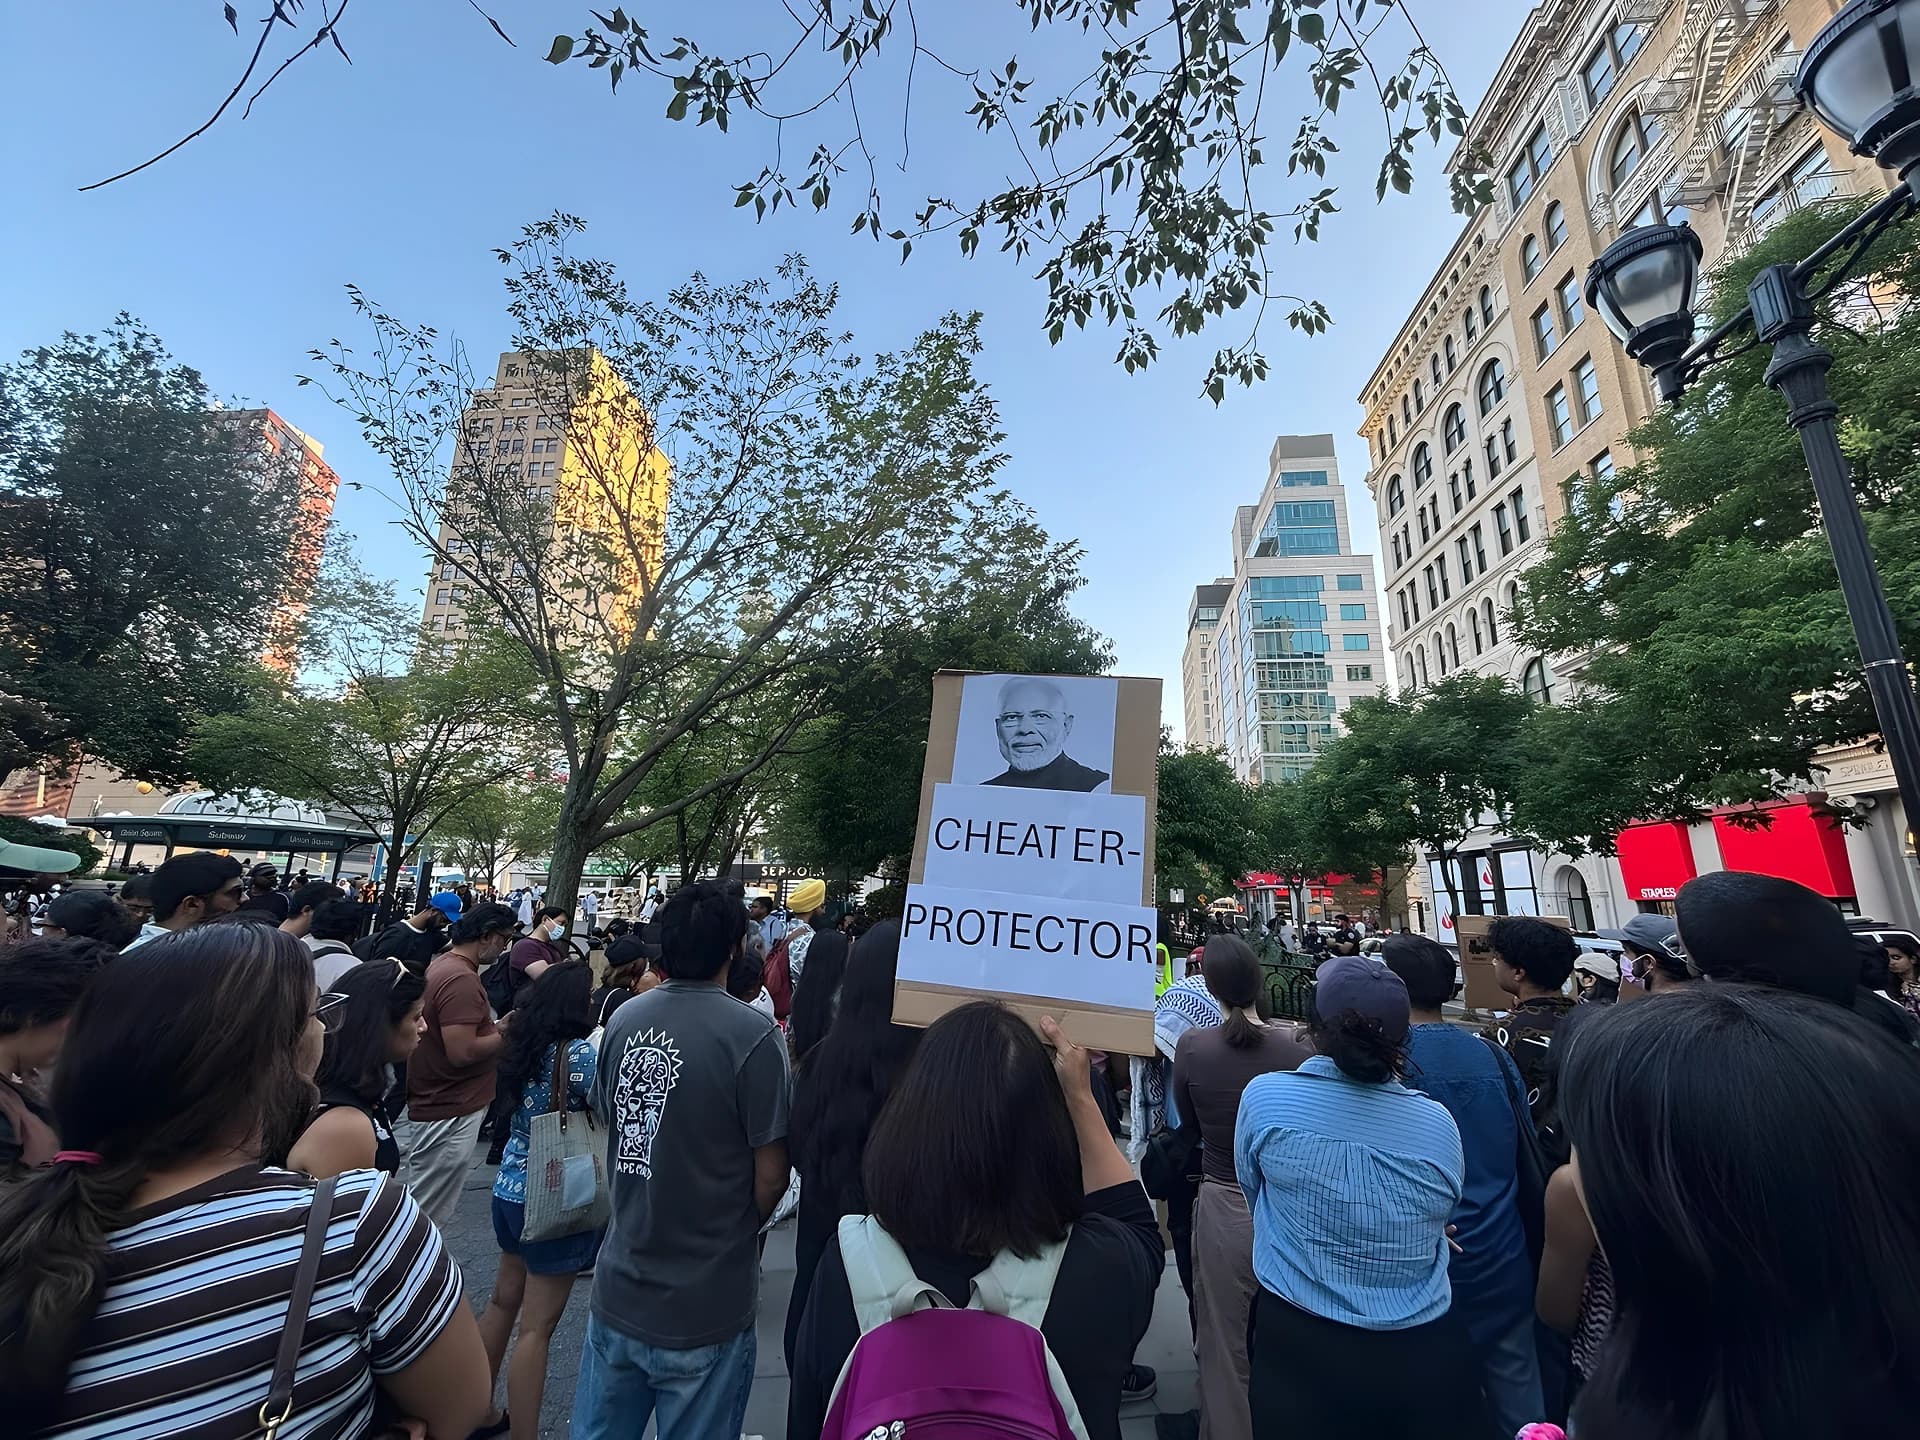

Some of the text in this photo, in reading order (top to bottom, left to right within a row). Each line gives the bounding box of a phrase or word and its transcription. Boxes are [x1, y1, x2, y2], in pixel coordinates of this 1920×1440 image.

[208, 830, 247, 841] Subway
[935, 817, 1141, 866] CHEATER-
[1641, 887, 1677, 898] STAPLES
[903, 903, 1153, 964] PROTECTOR
